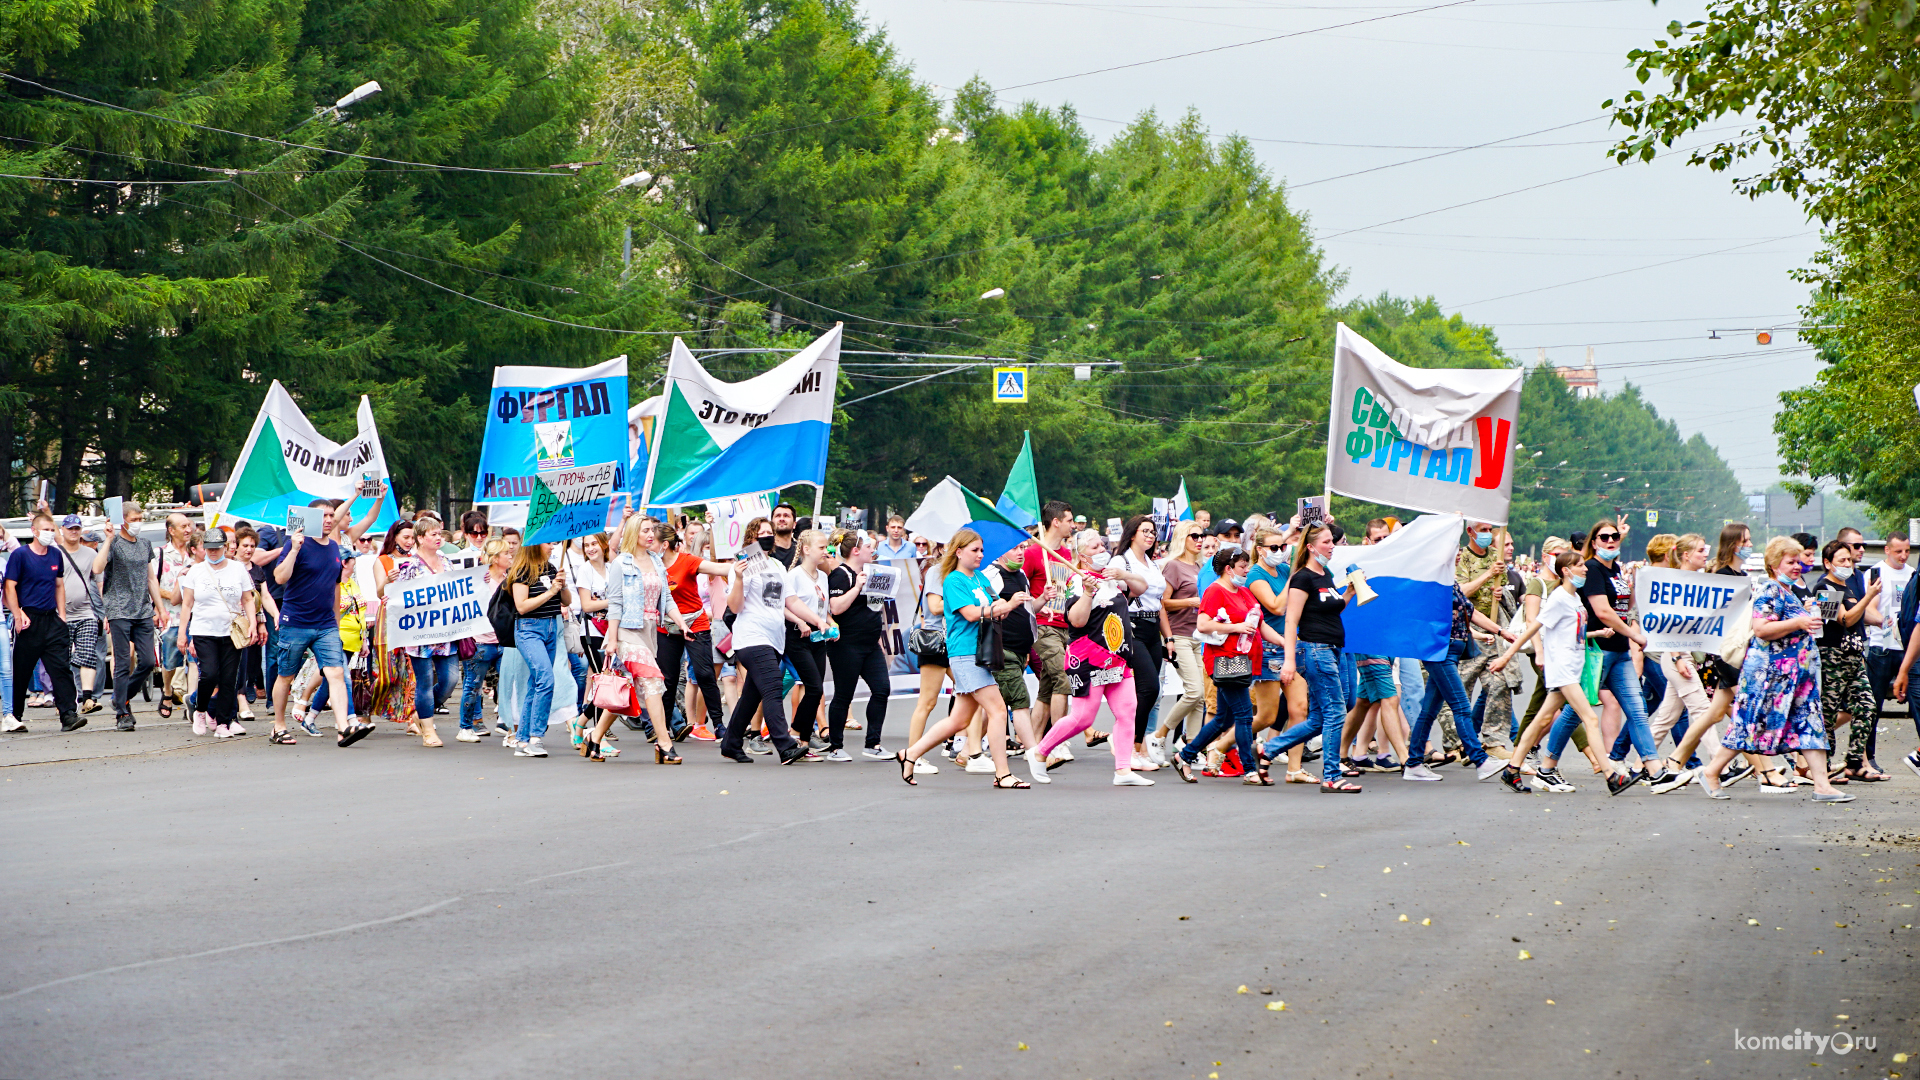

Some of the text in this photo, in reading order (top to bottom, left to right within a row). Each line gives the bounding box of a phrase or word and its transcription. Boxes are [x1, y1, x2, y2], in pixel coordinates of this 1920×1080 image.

[497, 381, 611, 424] ФУРГАЛ
[698, 399, 739, 424] ЭТО
[284, 439, 312, 467] ЭТО
[312, 455, 351, 477] НАШ
[483, 472, 534, 498] Наш
[536, 482, 609, 516] ВЕРНИТЕ
[403, 576, 475, 609] ВЕРНИТЕ
[1649, 580, 1735, 610] ВЕРНИТЕ
[398, 600, 483, 631] ФУРГАЛА
[1642, 611, 1725, 637] ФУРГАЛА
